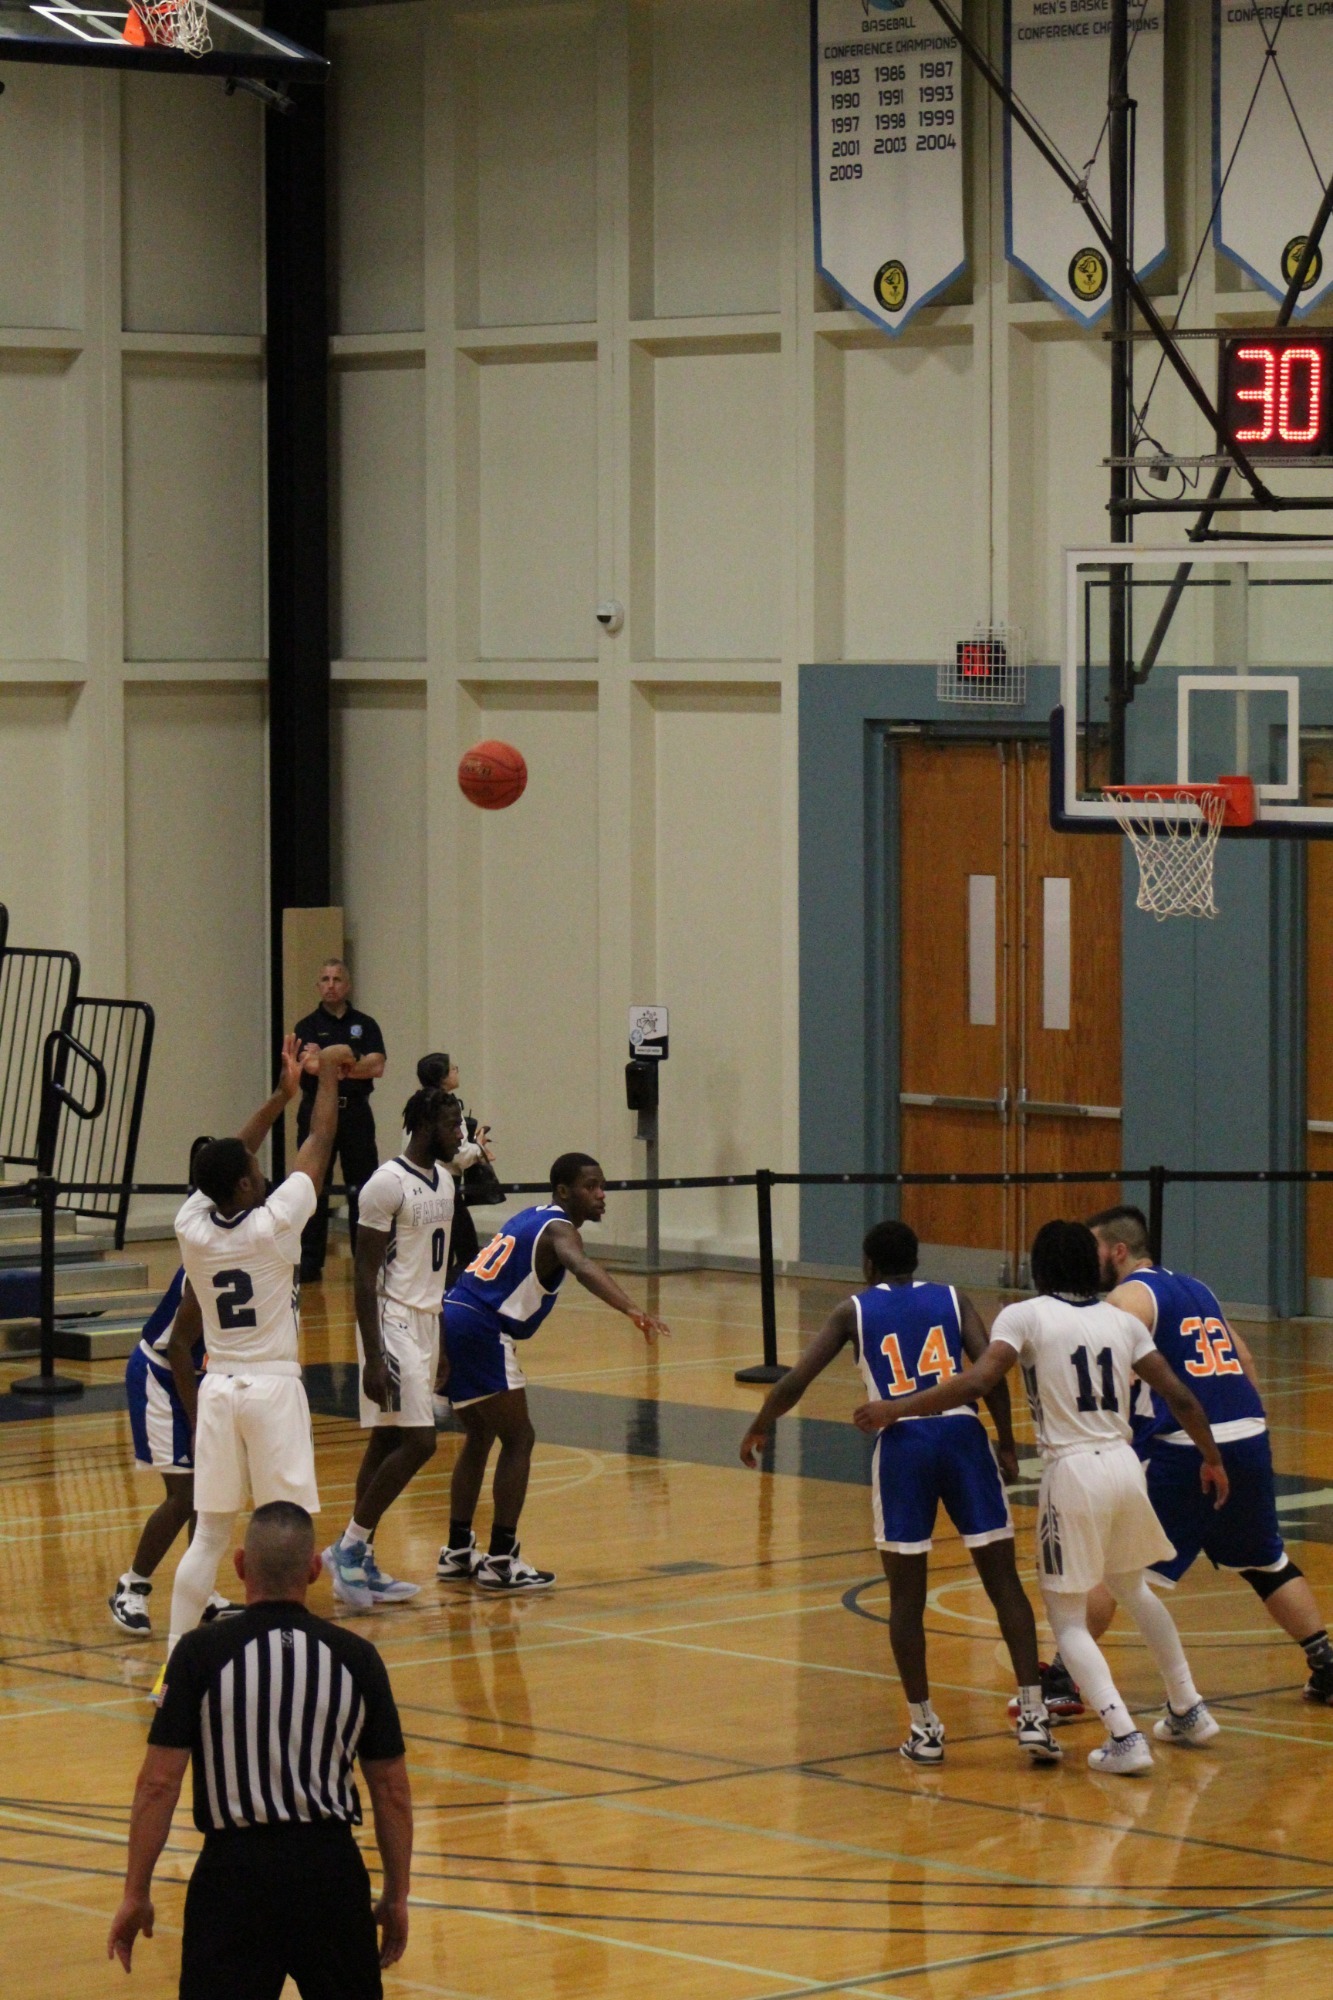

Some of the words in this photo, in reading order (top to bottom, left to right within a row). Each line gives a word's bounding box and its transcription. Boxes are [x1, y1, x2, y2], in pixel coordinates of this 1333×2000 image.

[1033, 0, 1067, 15] MEN'S
[1227, 4, 1304, 23] CONFERENCE
[862, 17, 916, 32] BASEBALL
[1018, 21, 1090, 40] CONFERENCE
[1093, 17, 1159, 35] CHAPIONS
[824, 42, 893, 59] CONFERENCE
[896, 36, 958, 53] CHAMPIONS
[830, 68, 860, 87] 1983
[875, 65, 906, 82] 1986
[919, 61, 954, 79] 1987
[831, 92, 860, 110] 1990
[878, 88, 904, 107] 1991
[919, 85, 954, 103] 1993
[831, 116, 860, 134] 1997
[875, 112, 906, 130] 1998
[919, 109, 955, 127] 1999
[832, 140, 860, 157] 2001
[873, 136, 907, 154] 2003
[916, 133, 957, 151] 2004
[829, 163, 863, 181] 2009
[1236, 348, 1320, 440] 30
[431, 1227, 445, 1273] 0
[212, 1268, 257, 1330] 2
[1179, 1316, 1244, 1378] 32
[880, 1325, 957, 1397] 14
[1070, 1345, 1119, 1412] 11
